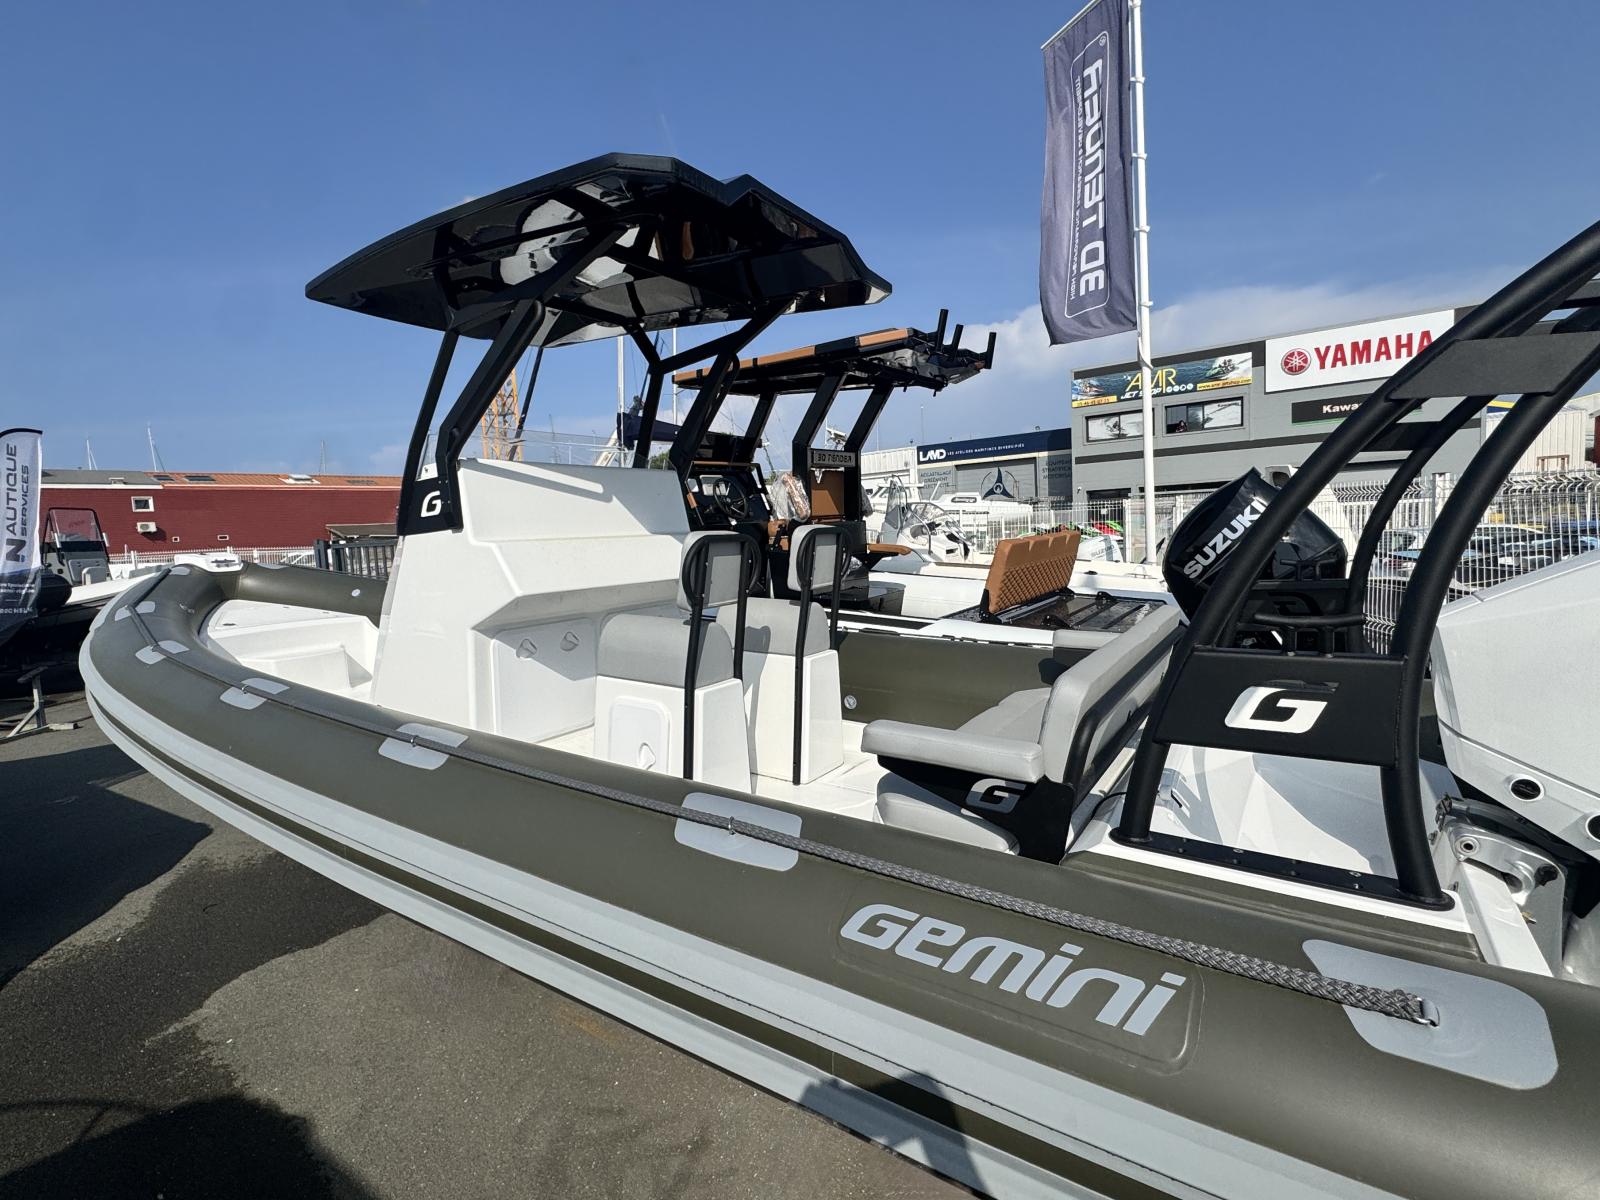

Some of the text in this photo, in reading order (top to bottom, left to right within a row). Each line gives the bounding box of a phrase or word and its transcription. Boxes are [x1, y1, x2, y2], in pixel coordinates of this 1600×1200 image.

[1314, 330, 1434, 370] YAMAHA
[1139, 387, 1162, 397] SOP
[1322, 403, 1363, 414] Kawa
[20, 464, 29, 537] SERVICES
[420, 490, 442, 518] G
[1183, 495, 1269, 579] SUZUKI
[1224, 679, 1340, 734] G
[965, 778, 1027, 815] G
